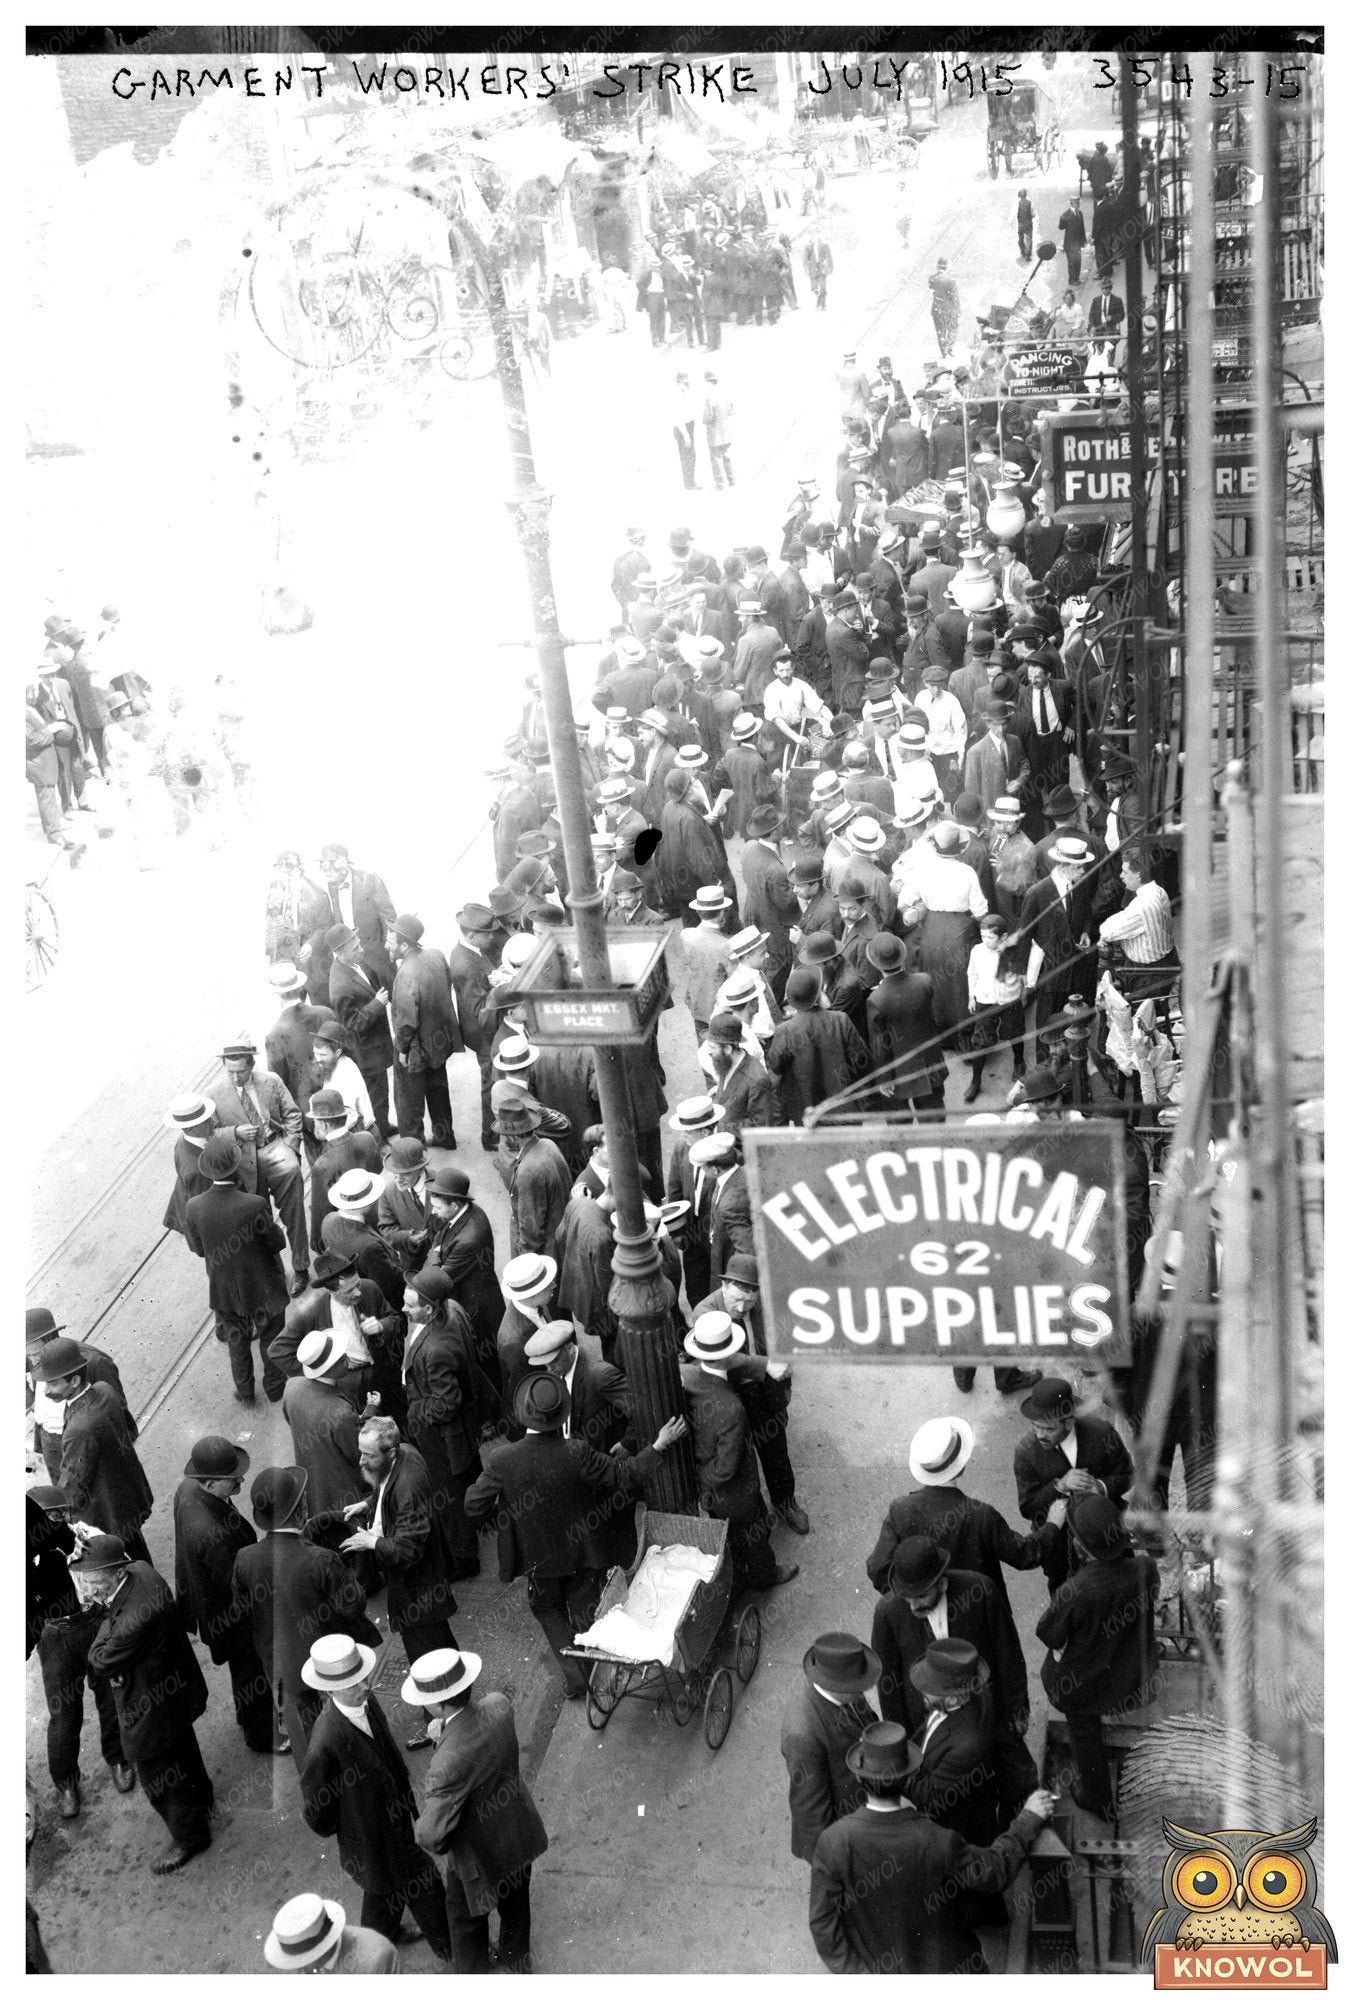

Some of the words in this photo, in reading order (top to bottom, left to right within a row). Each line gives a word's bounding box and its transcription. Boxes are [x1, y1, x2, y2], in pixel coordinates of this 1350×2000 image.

[544, 1003, 588, 1014] ESSEX
[563, 1016, 604, 1027] PLACE
[762, 1147, 1106, 1267] ELECTRICAL
[787, 1284, 1113, 1347] SUPPLIES
